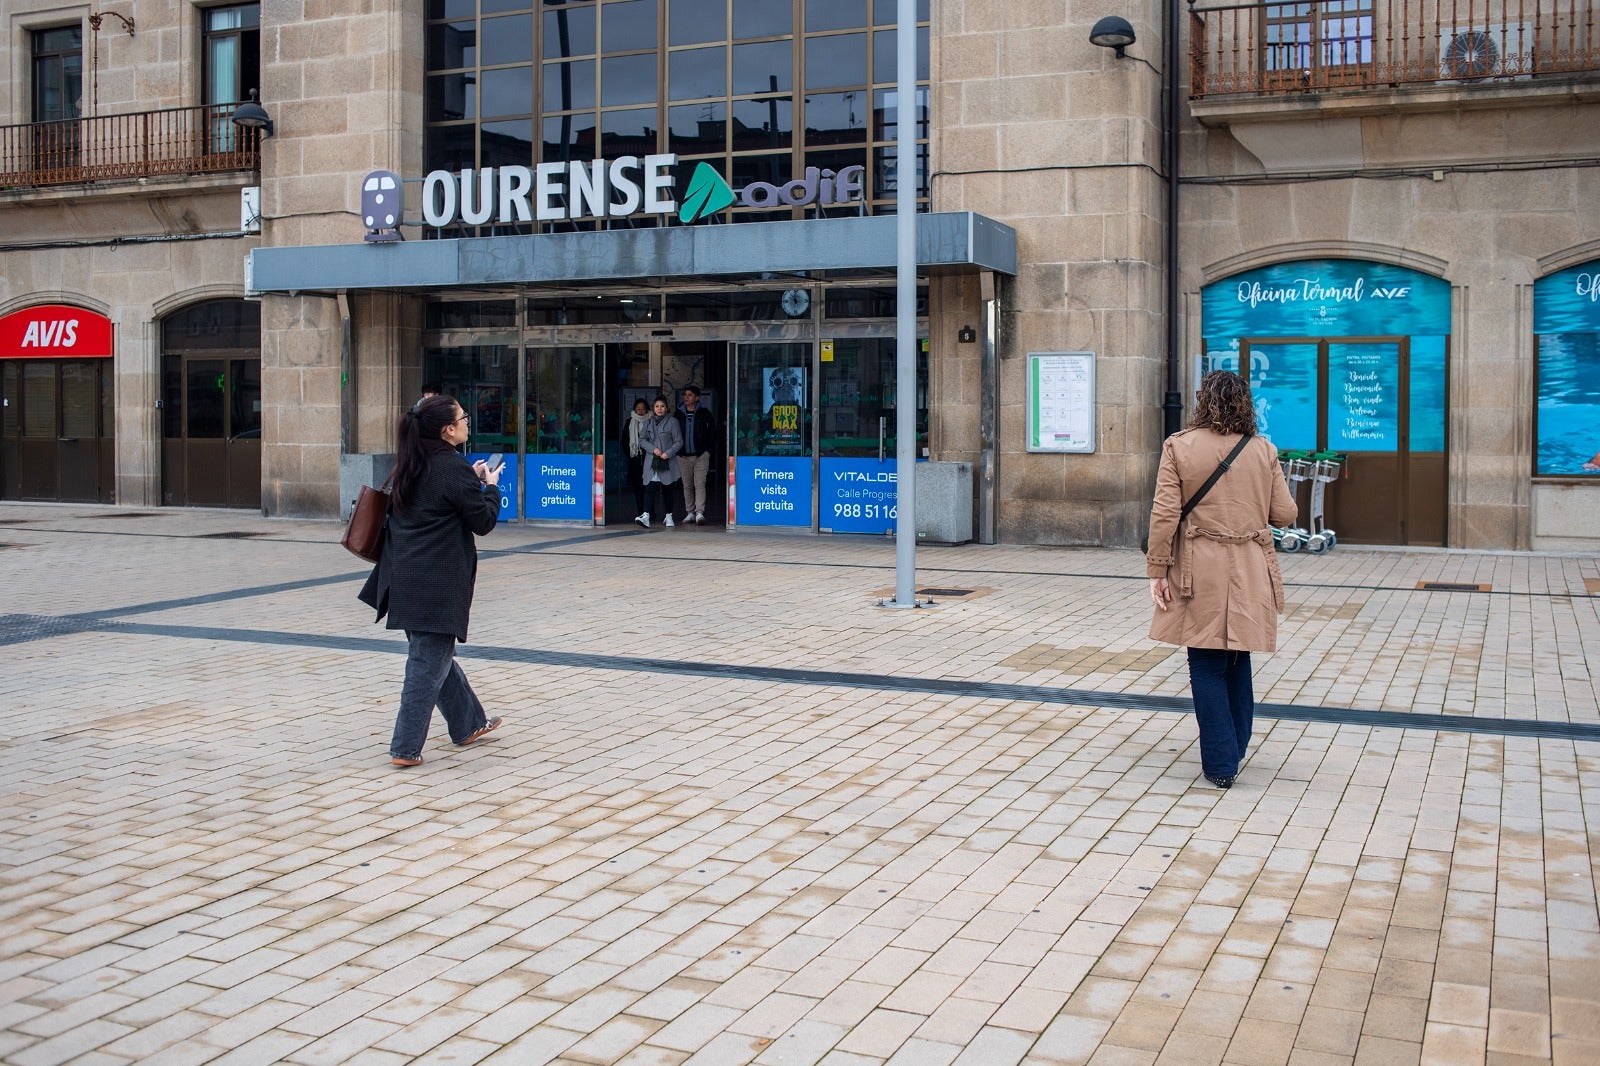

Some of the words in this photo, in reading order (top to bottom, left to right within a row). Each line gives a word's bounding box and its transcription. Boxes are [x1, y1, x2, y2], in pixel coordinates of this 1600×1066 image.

[422, 153, 678, 227] OURENSE
[741, 165, 865, 208] adif
[1238, 281, 1300, 308] Oficina
[1294, 277, 1364, 302] Termal
[1370, 287, 1411, 299] AVE
[21, 319, 79, 347] AVIS
[772, 416, 798, 429] MAX
[541, 465, 577, 476] Primera
[754, 468, 794, 480] Primera
[833, 471, 897, 482] VITALDE
[547, 480, 571, 491] visita
[760, 484, 787, 495] visita
[541, 495, 577, 507] gratuita
[837, 488, 860, 498] Calle
[862, 488, 897, 501] Progres
[754, 499, 794, 513] gratuita
[834, 503, 861, 518] 988
